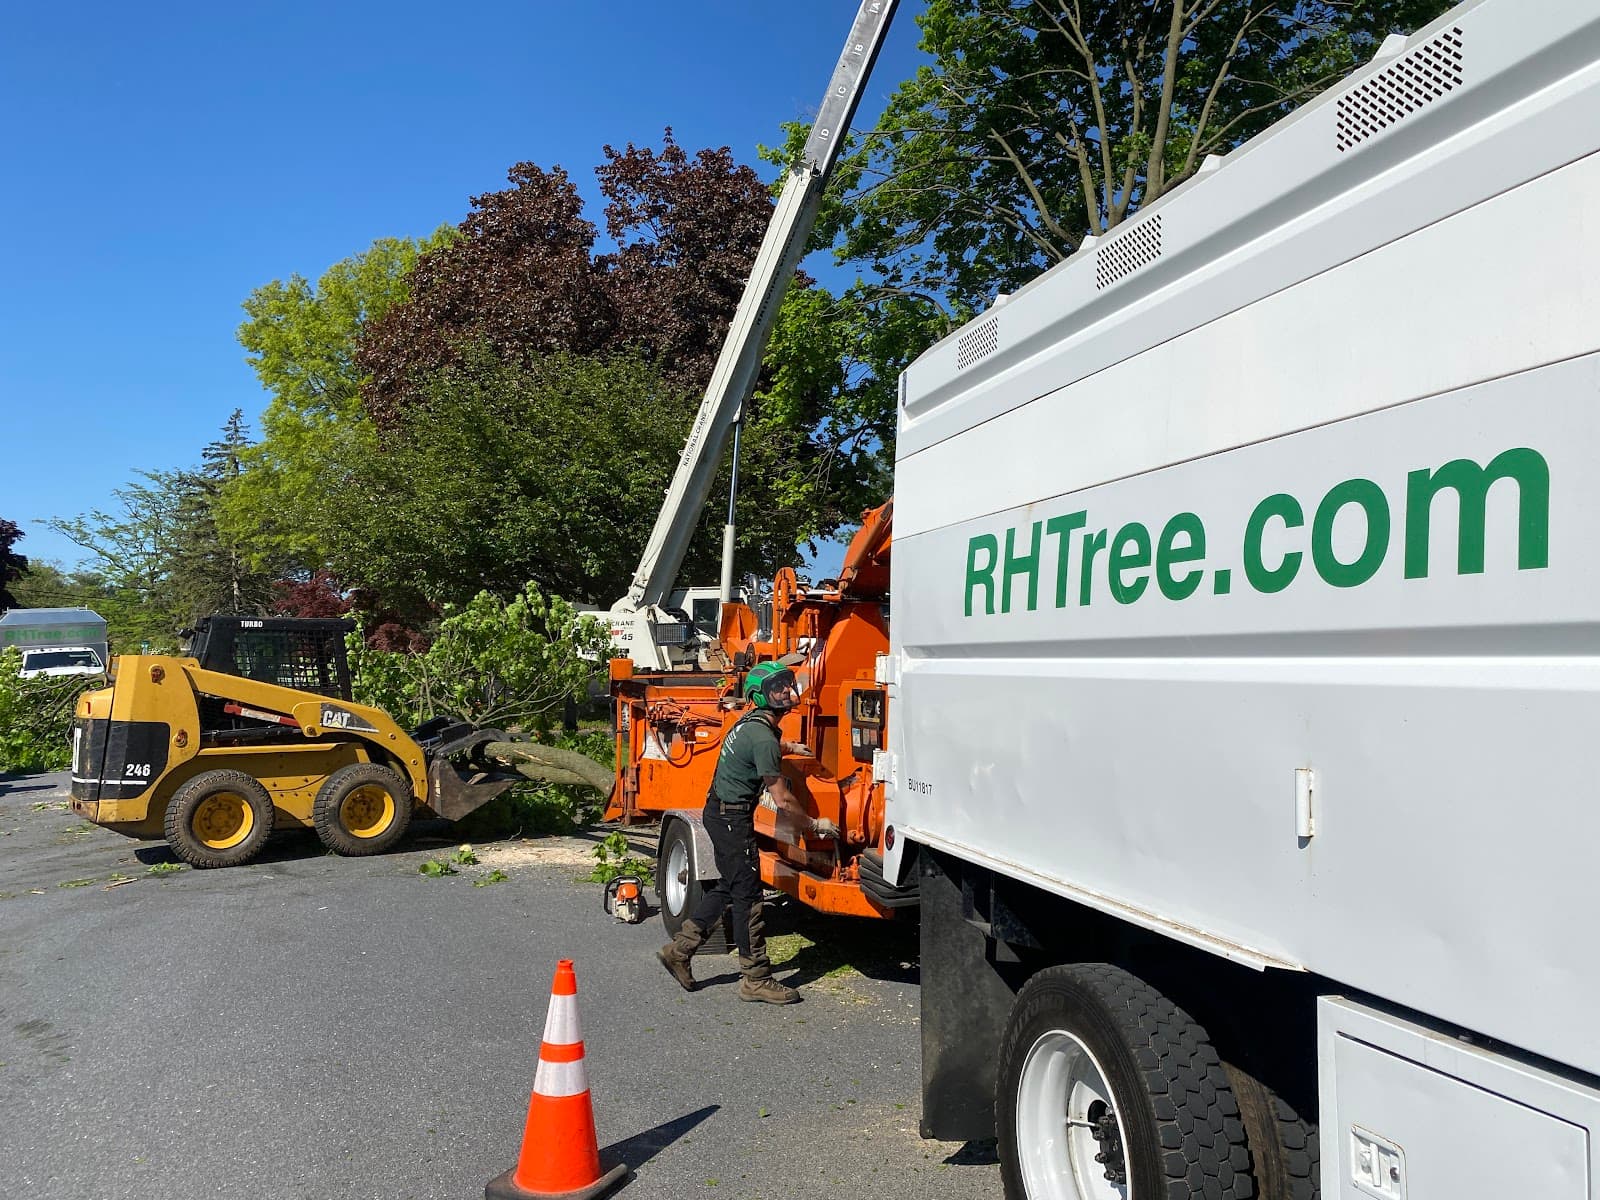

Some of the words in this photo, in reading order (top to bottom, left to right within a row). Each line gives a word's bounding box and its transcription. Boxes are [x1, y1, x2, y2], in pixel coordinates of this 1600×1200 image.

[683, 434, 699, 467] NATIONAL
[965, 447, 1549, 617] RHTree.com
[240, 620, 264, 628] TURBO
[621, 633, 633, 641] 45
[322, 710, 351, 728] CAT
[125, 763, 151, 777] 246
[908, 778, 933, 795] BU11817
